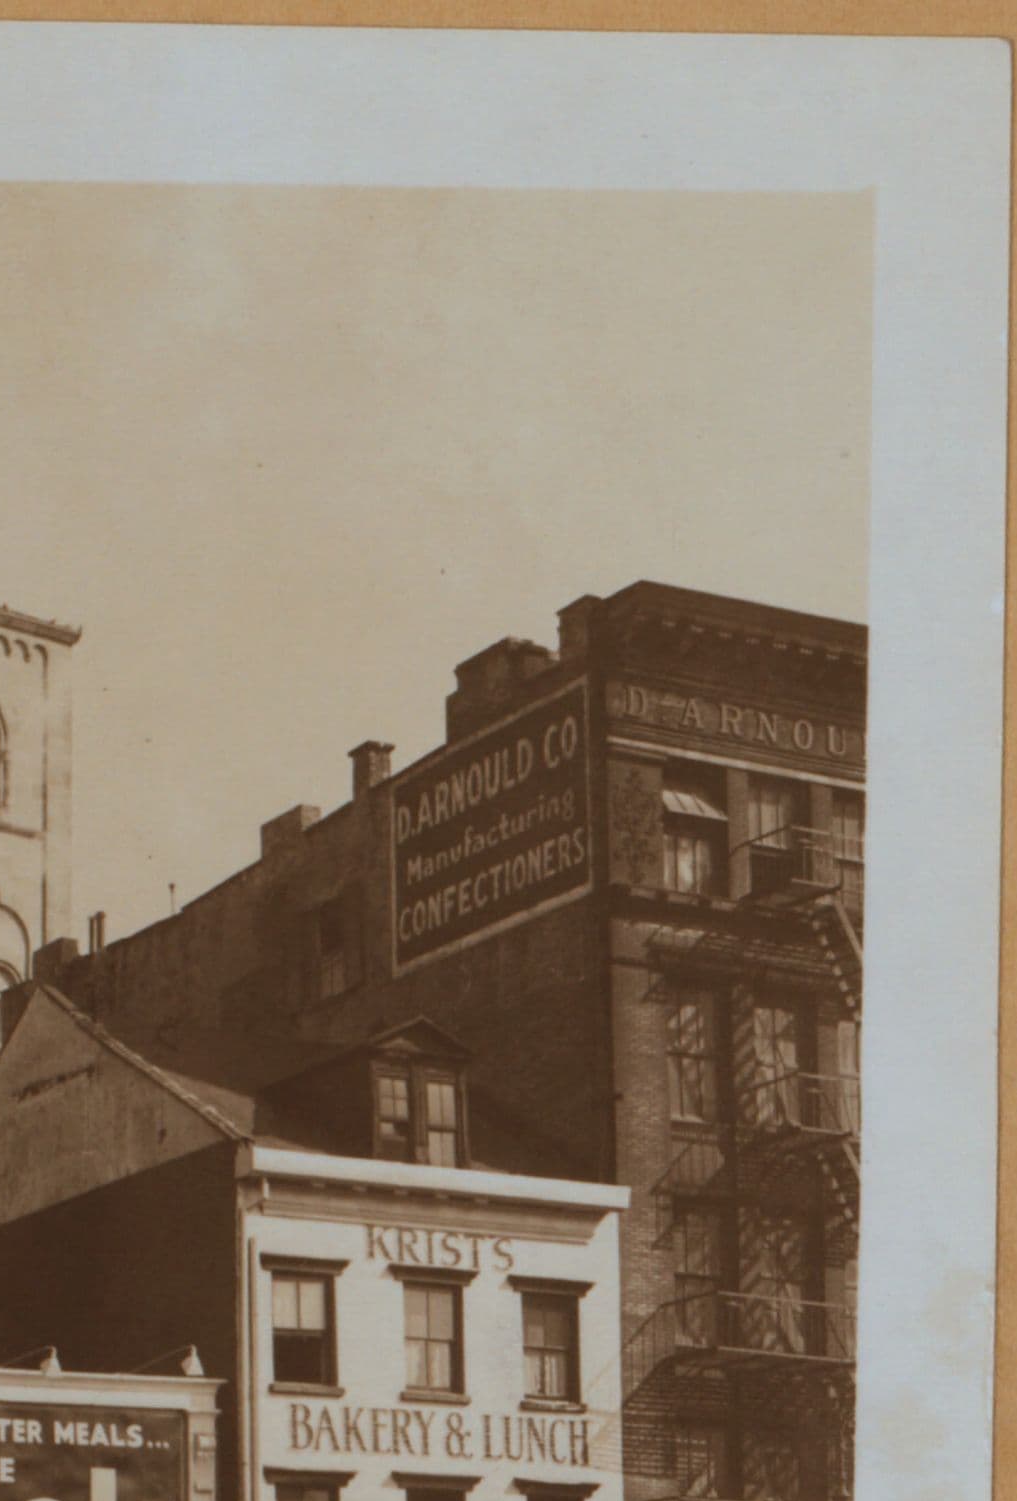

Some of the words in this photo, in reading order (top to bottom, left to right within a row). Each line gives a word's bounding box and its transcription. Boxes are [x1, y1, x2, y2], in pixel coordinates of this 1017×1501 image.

[544, 716, 577, 768] CO
[407, 788, 576, 885] Manufacturing
[399, 827, 585, 942] CONFECTIONERS
[289, 1403, 436, 1458] BAKERY
[445, 1412, 474, 1459] &
[483, 1414, 591, 1467] LUNCH
